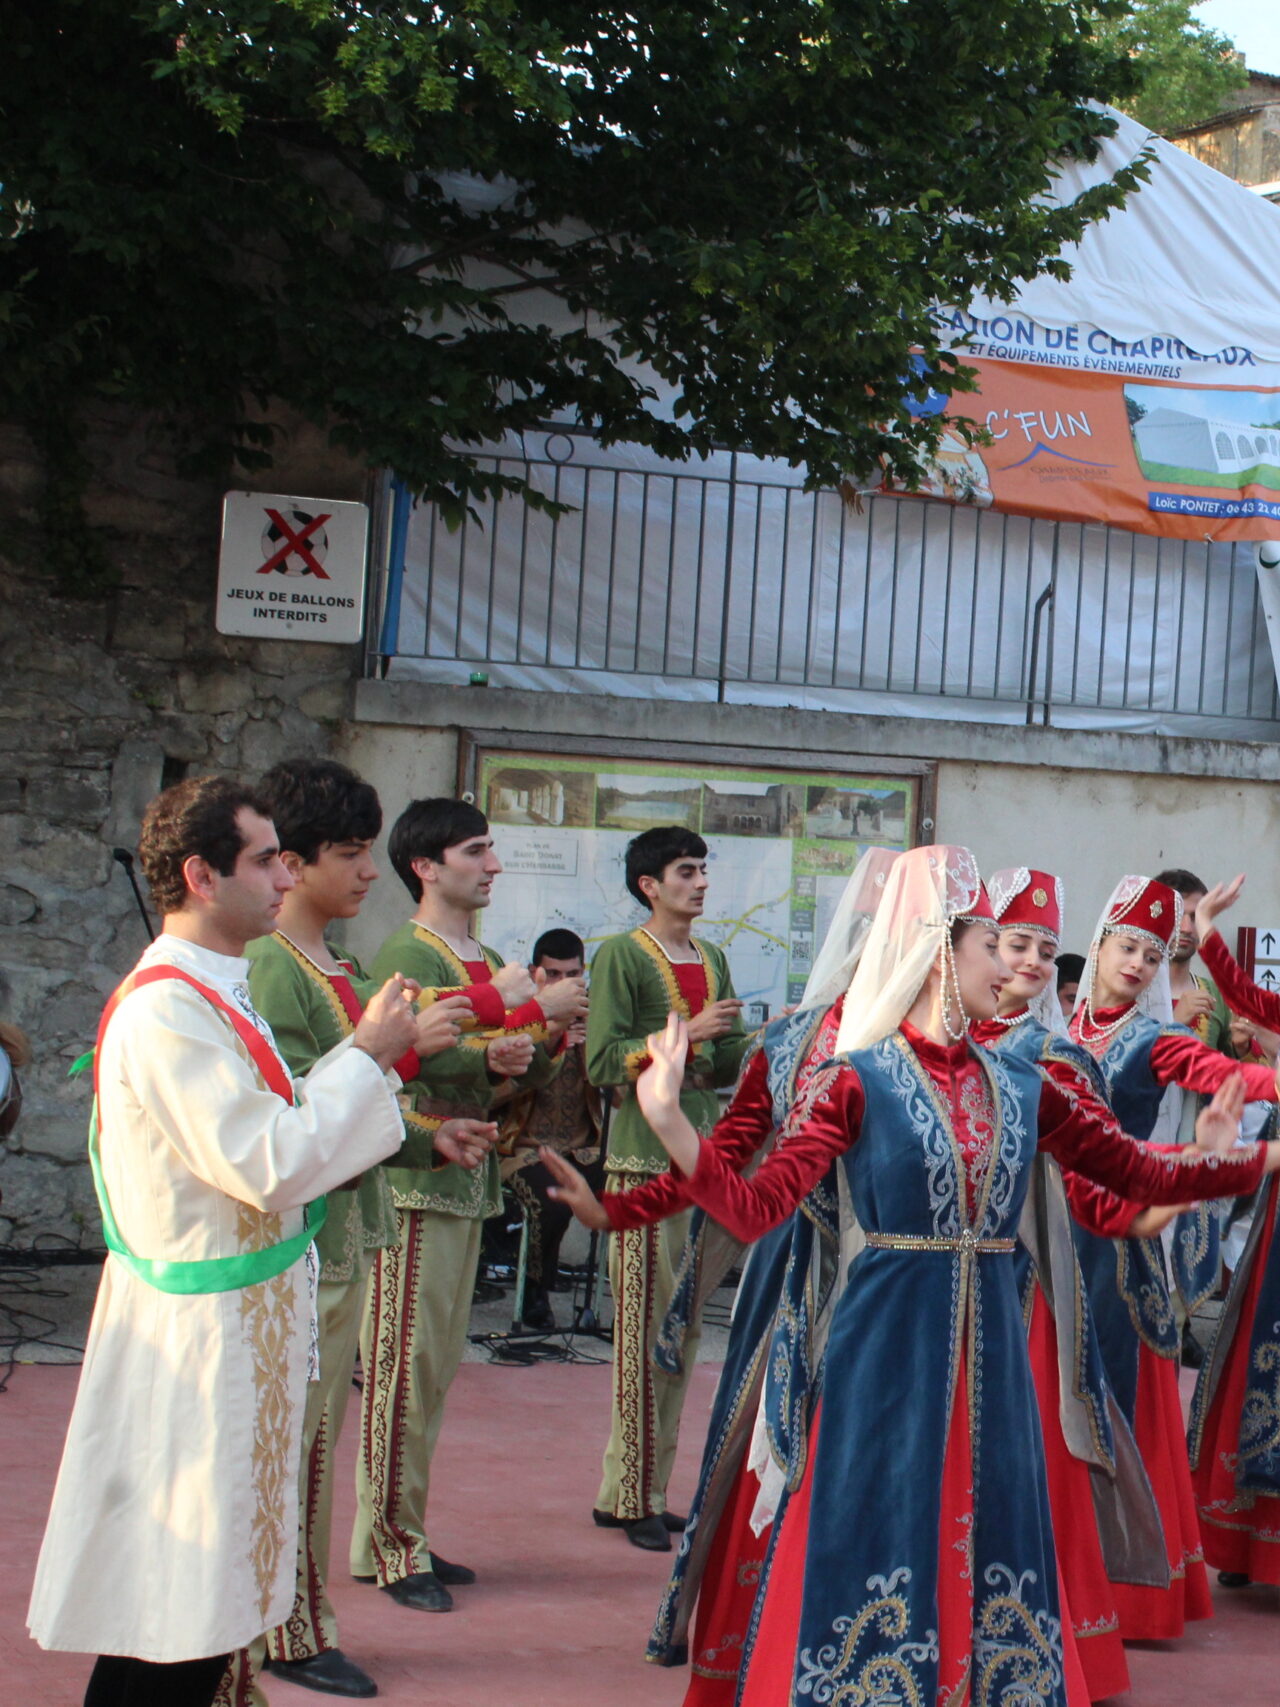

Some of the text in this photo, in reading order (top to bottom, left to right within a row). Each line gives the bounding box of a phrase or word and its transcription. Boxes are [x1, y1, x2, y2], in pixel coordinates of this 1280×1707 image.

[1045, 325, 1079, 351] DE
[969, 341, 1182, 379] ET ÉQUIPEMENTS ÉVÈNEMENTIELS
[985, 408, 1093, 442] C'FUN
[1155, 496, 1177, 509] Loïc
[1226, 503, 1240, 514] 06
[1241, 502, 1254, 514] 43
[227, 588, 355, 609] JEUX DE BALLONS
[253, 607, 328, 623] INTERDITS
